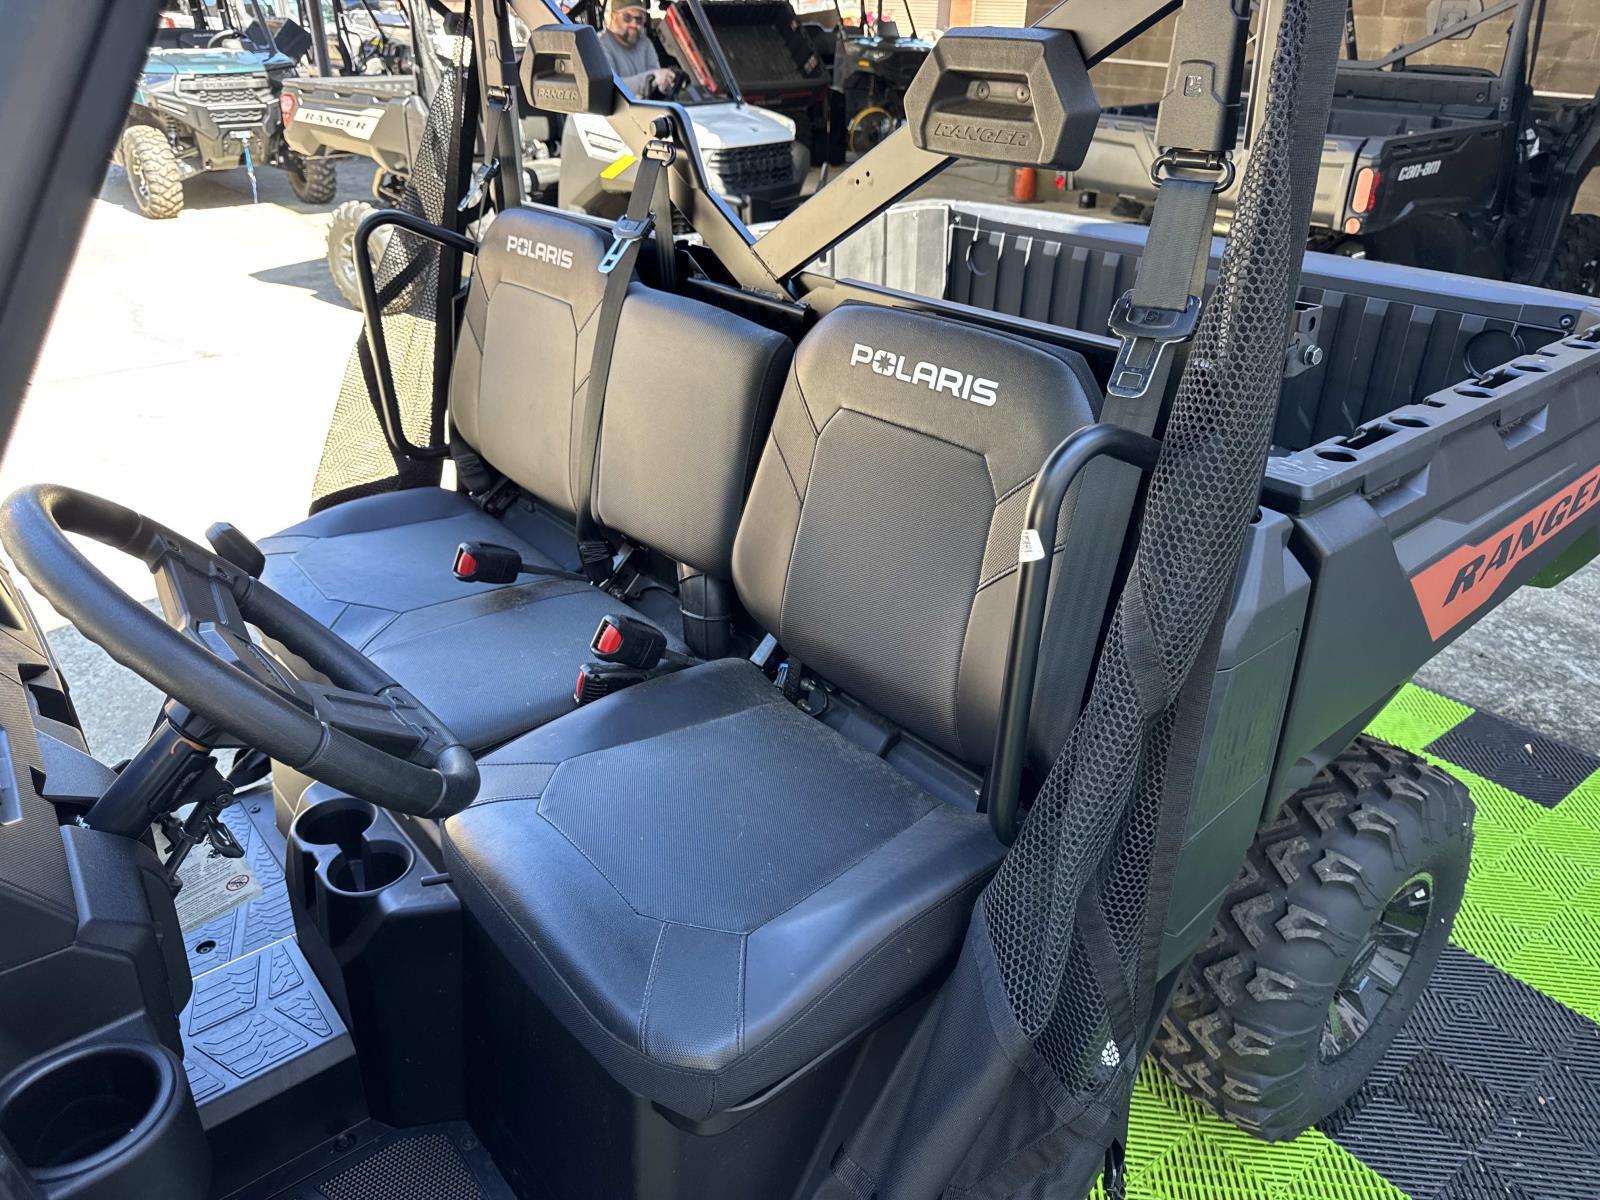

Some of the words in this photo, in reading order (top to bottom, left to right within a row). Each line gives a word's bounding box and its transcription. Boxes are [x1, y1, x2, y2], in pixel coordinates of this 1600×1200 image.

[536, 87, 578, 101] RANGER
[305, 112, 366, 130] RANGER
[934, 122, 1033, 147] RANGER
[506, 234, 574, 269] POLARIS
[850, 343, 999, 407] POLARIS
